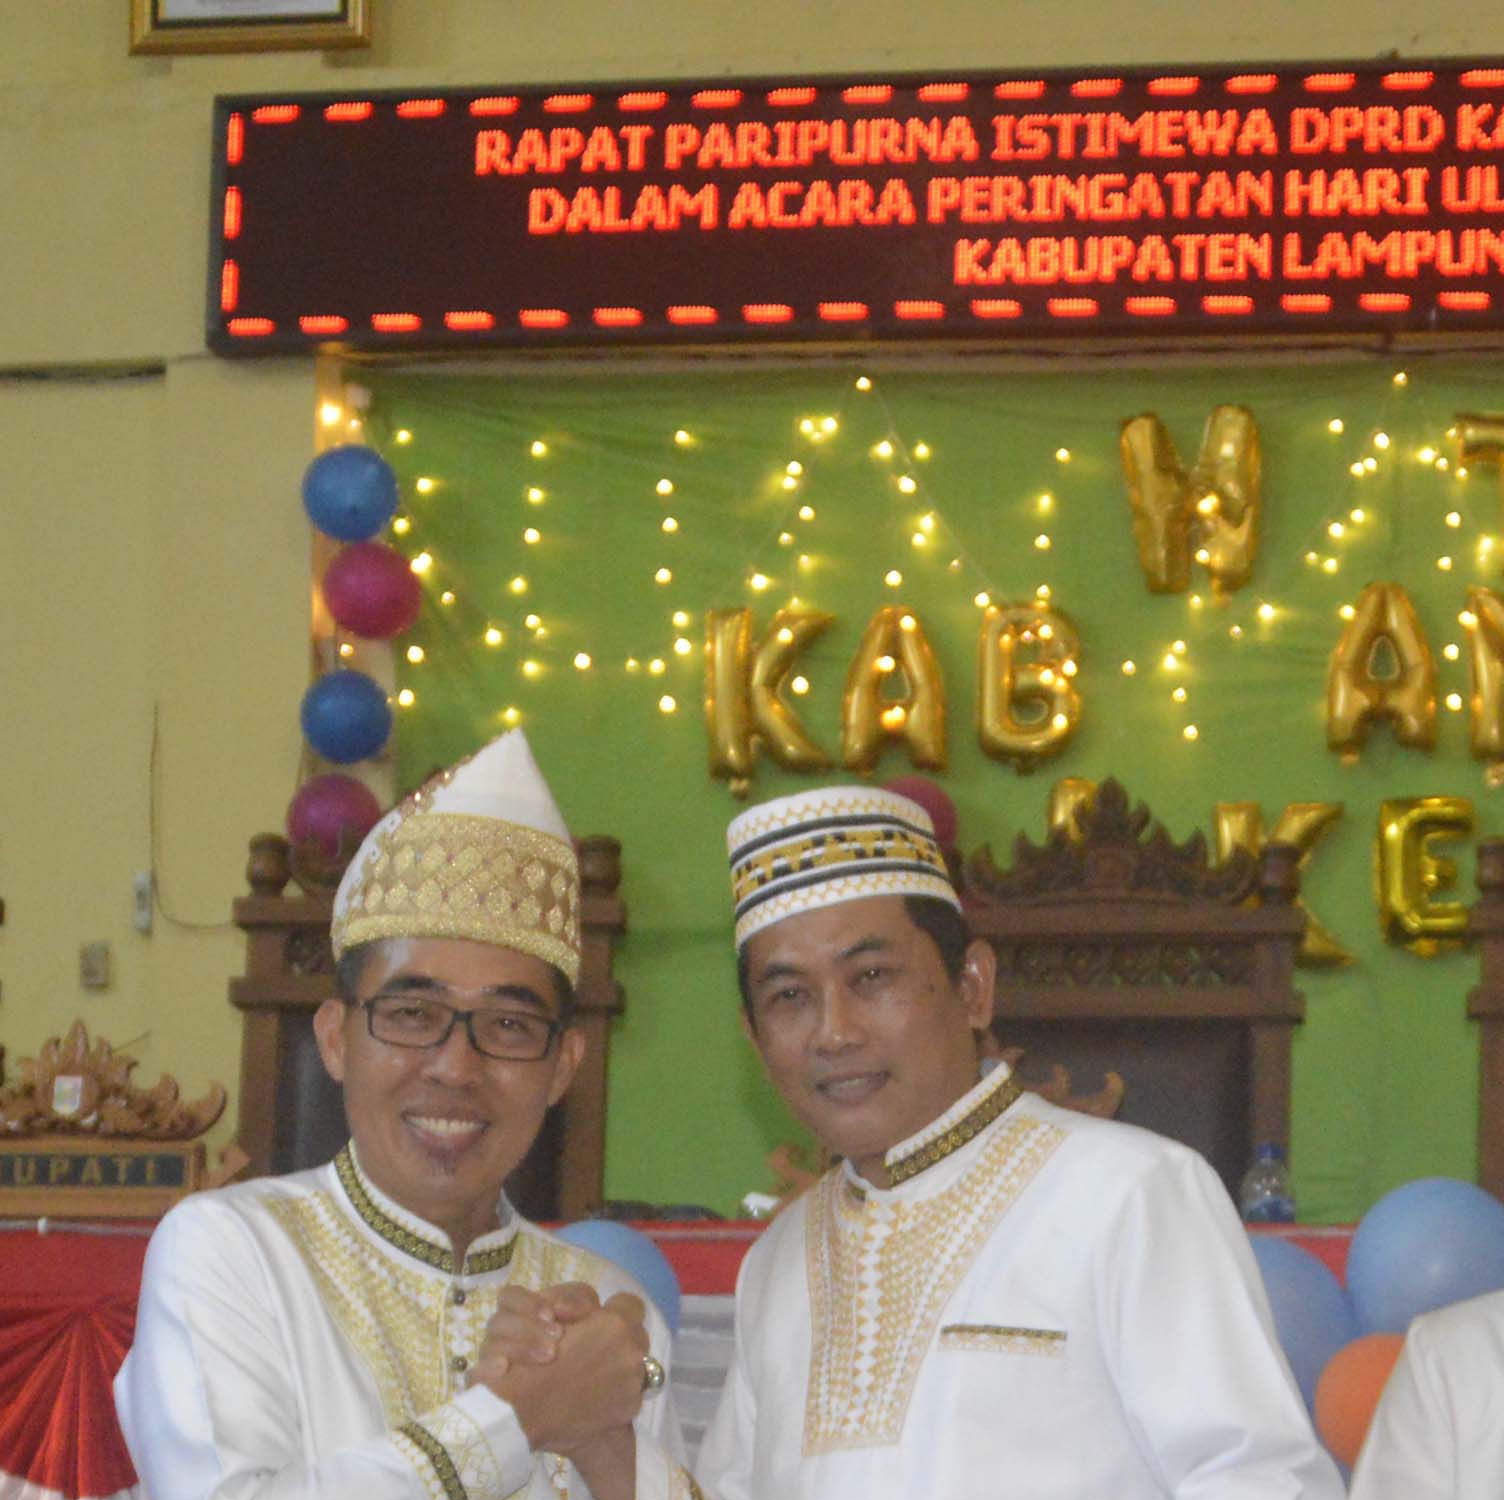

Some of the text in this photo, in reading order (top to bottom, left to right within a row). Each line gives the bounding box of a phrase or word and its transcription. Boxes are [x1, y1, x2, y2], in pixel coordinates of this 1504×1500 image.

[474, 122, 654, 176] RAPAT
[663, 115, 980, 171] PARIPURNA
[990, 107, 1278, 161] ISTIMEWA
[1289, 103, 1445, 155] DPRD
[527, 182, 719, 236] DALAM
[727, 177, 917, 230] ACARA
[926, 169, 1274, 225] PERINGATAN
[1282, 166, 1430, 219] HARI
[952, 232, 1273, 286] KABUPATEN
